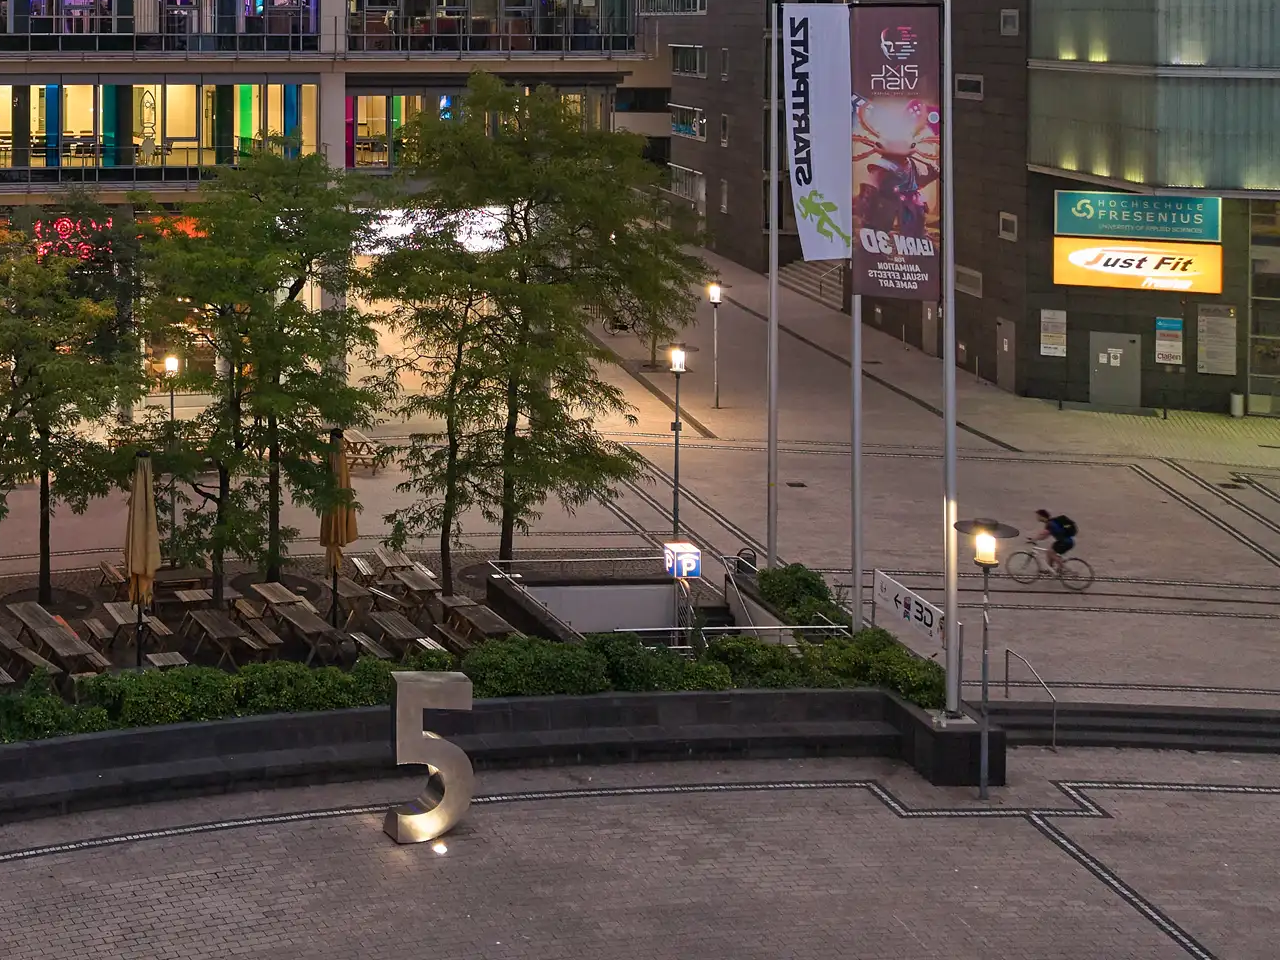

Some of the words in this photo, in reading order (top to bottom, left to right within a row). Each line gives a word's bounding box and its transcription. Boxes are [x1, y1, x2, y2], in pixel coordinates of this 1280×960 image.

[1098, 199, 1203, 211] HOCHSCHULE
[1098, 210, 1203, 224] FRESENIUS
[1084, 252, 1148, 269] Just
[1153, 256, 1194, 272] Fit
[382, 671, 474, 844] 5
